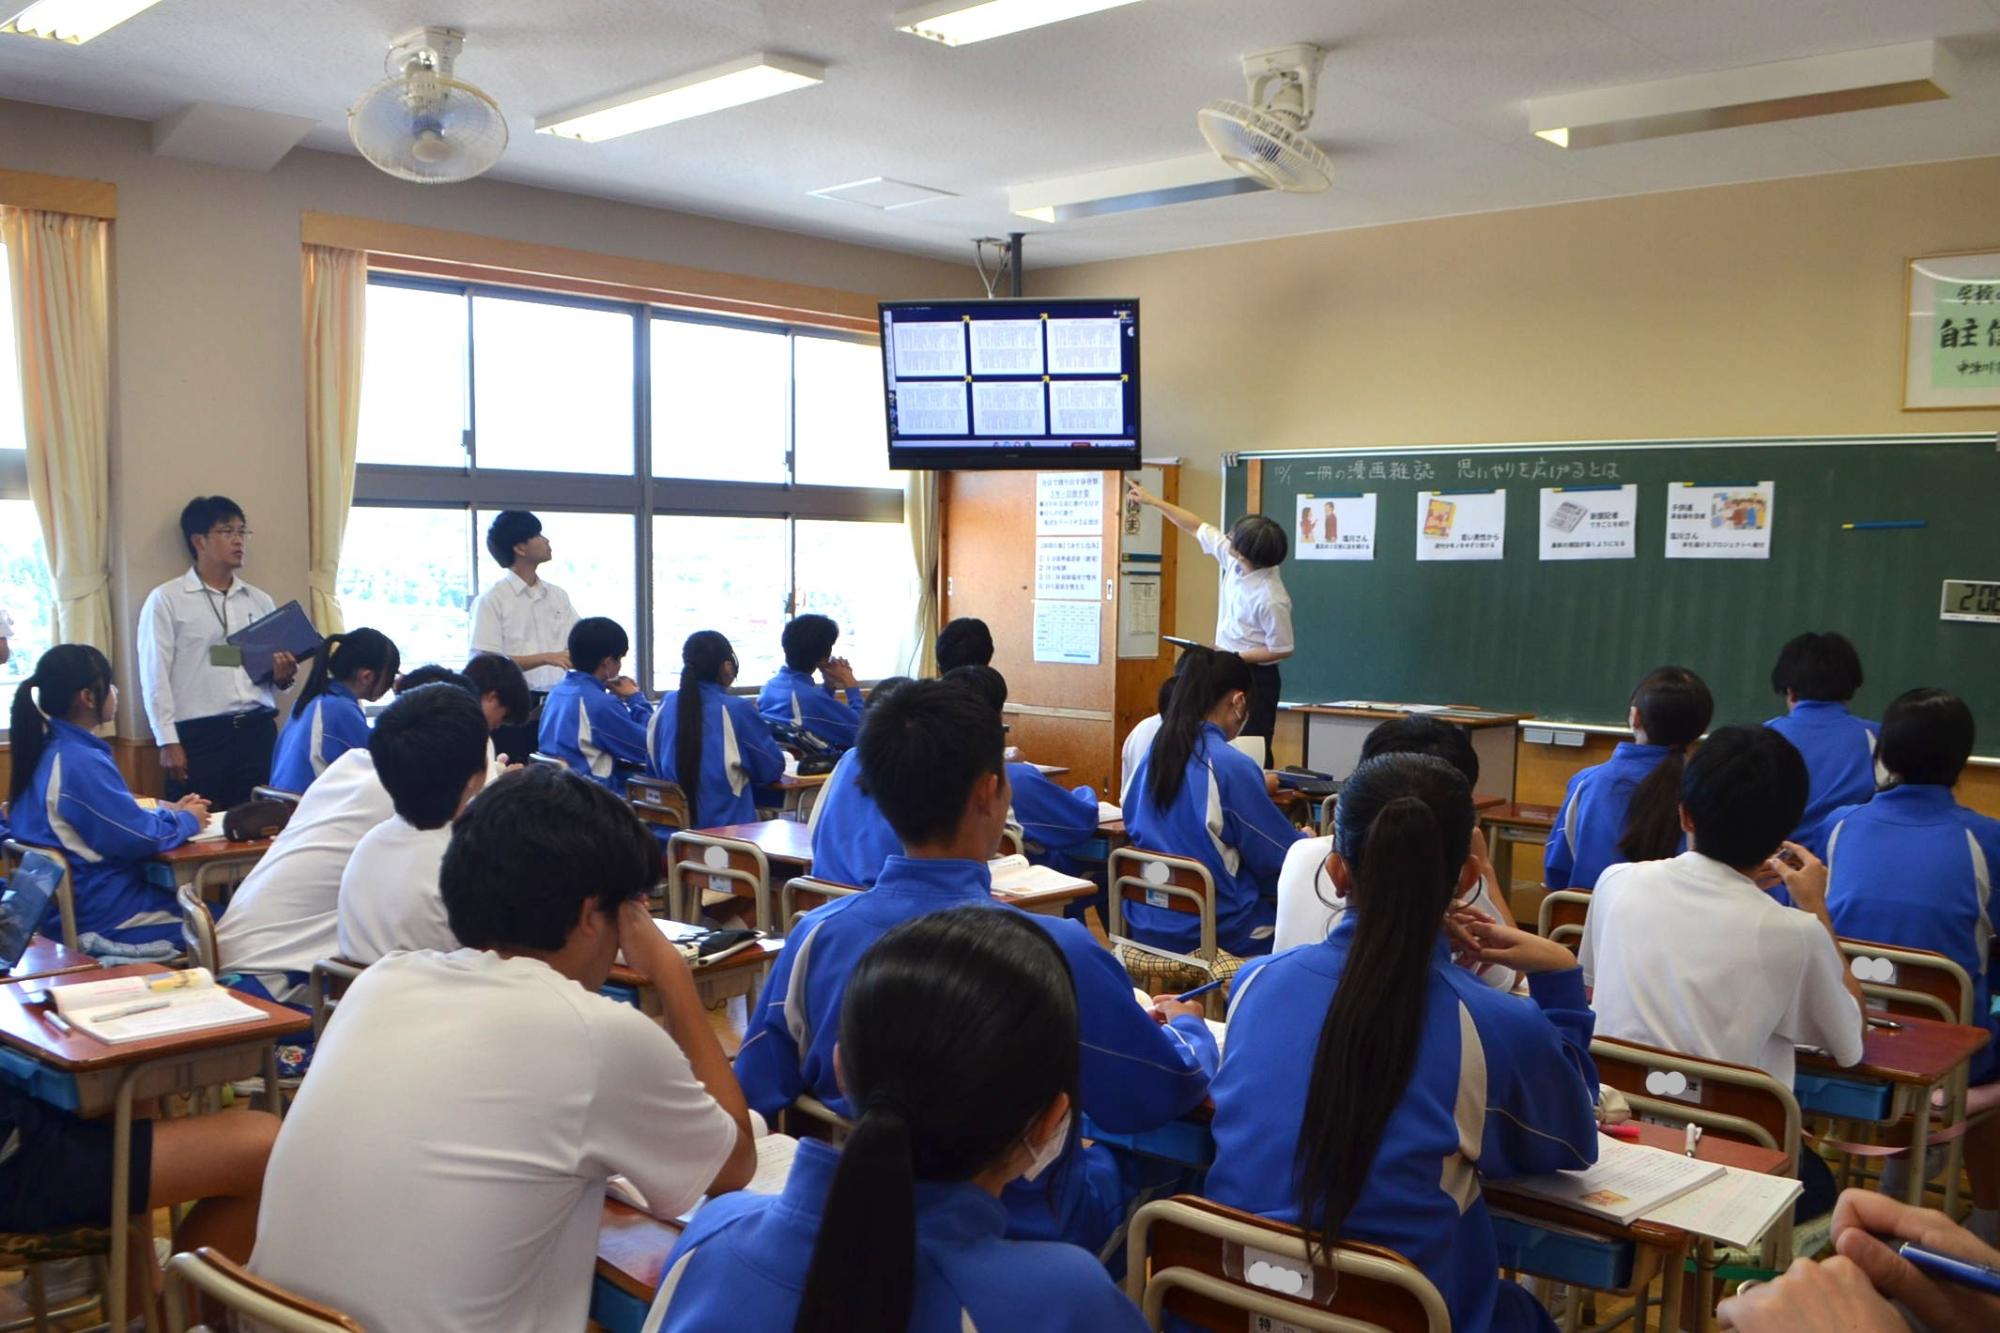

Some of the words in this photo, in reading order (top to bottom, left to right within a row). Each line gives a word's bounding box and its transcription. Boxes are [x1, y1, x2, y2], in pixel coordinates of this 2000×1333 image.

[1304, 459, 1435, 481] 一冊の漫画雑誌
[1457, 456, 1621, 480] 思いやりを広げるとは
